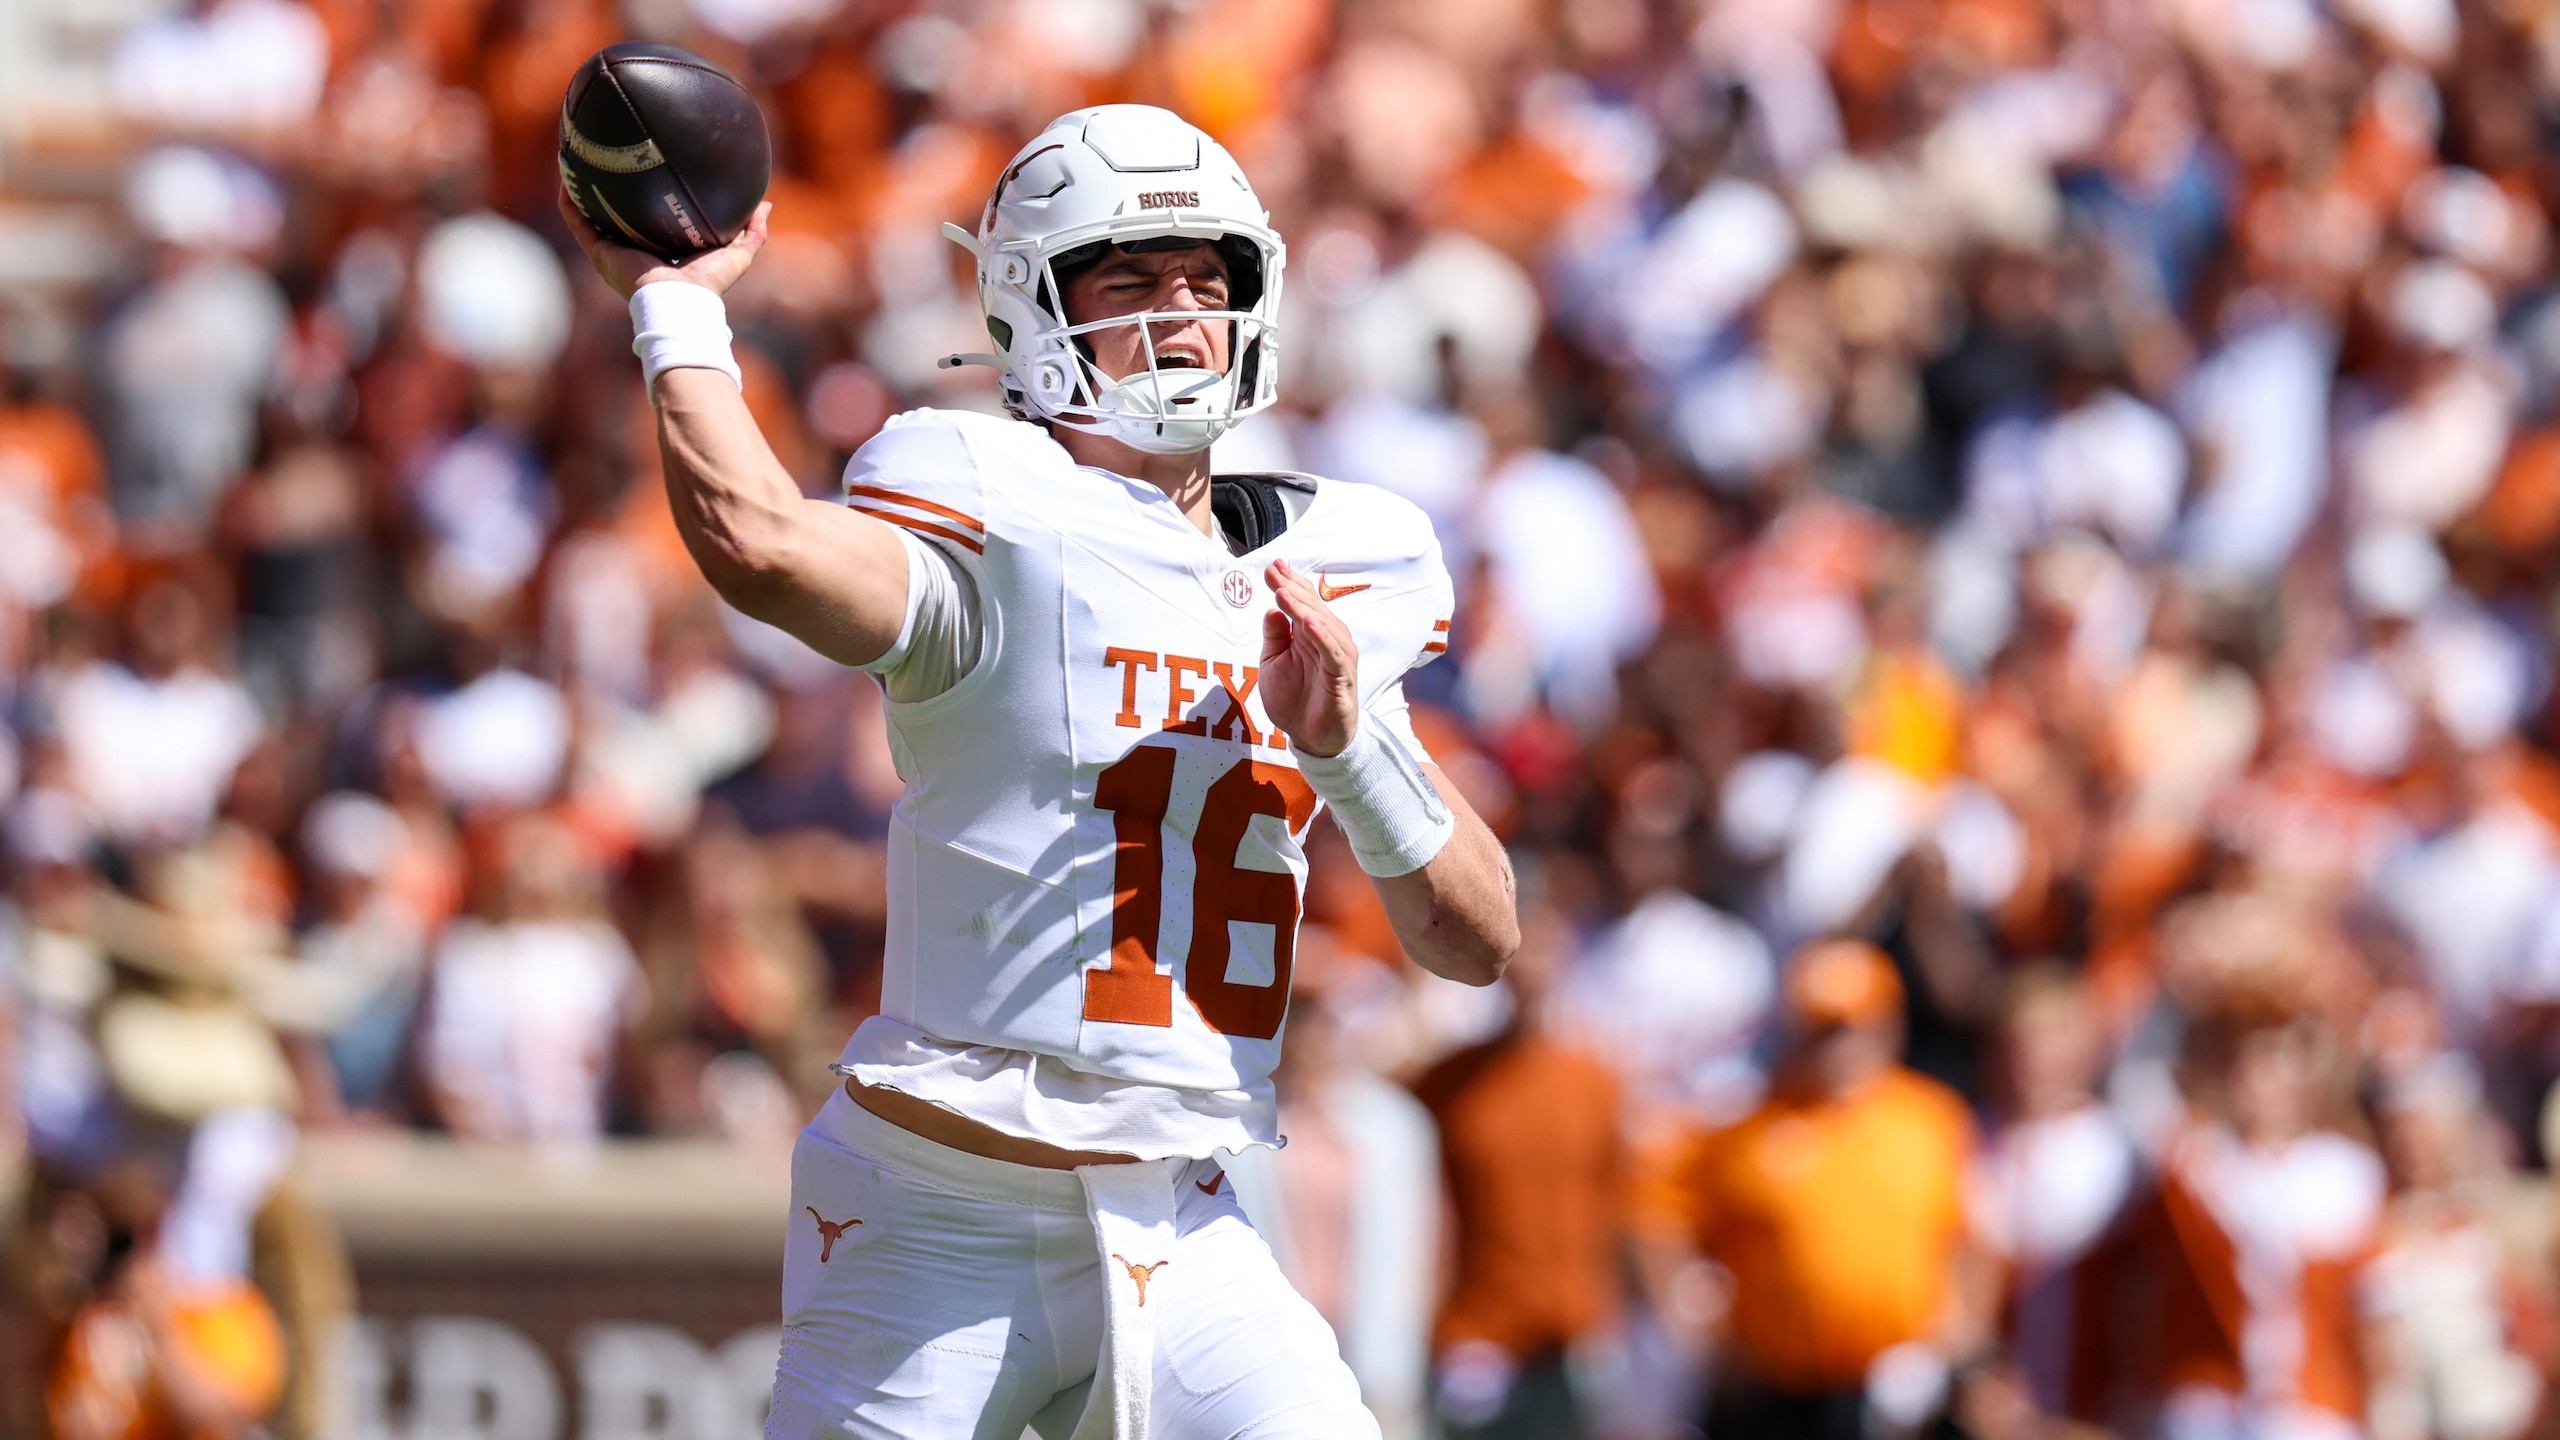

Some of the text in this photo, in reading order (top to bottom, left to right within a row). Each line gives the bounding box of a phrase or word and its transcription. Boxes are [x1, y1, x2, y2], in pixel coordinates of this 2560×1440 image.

[663, 192, 693, 228] ELITE
[1137, 190, 1200, 210] HORNS
[1223, 570, 1252, 606] SEC
[1104, 646, 1287, 750] TEX
[1084, 745, 1318, 1040] 16
